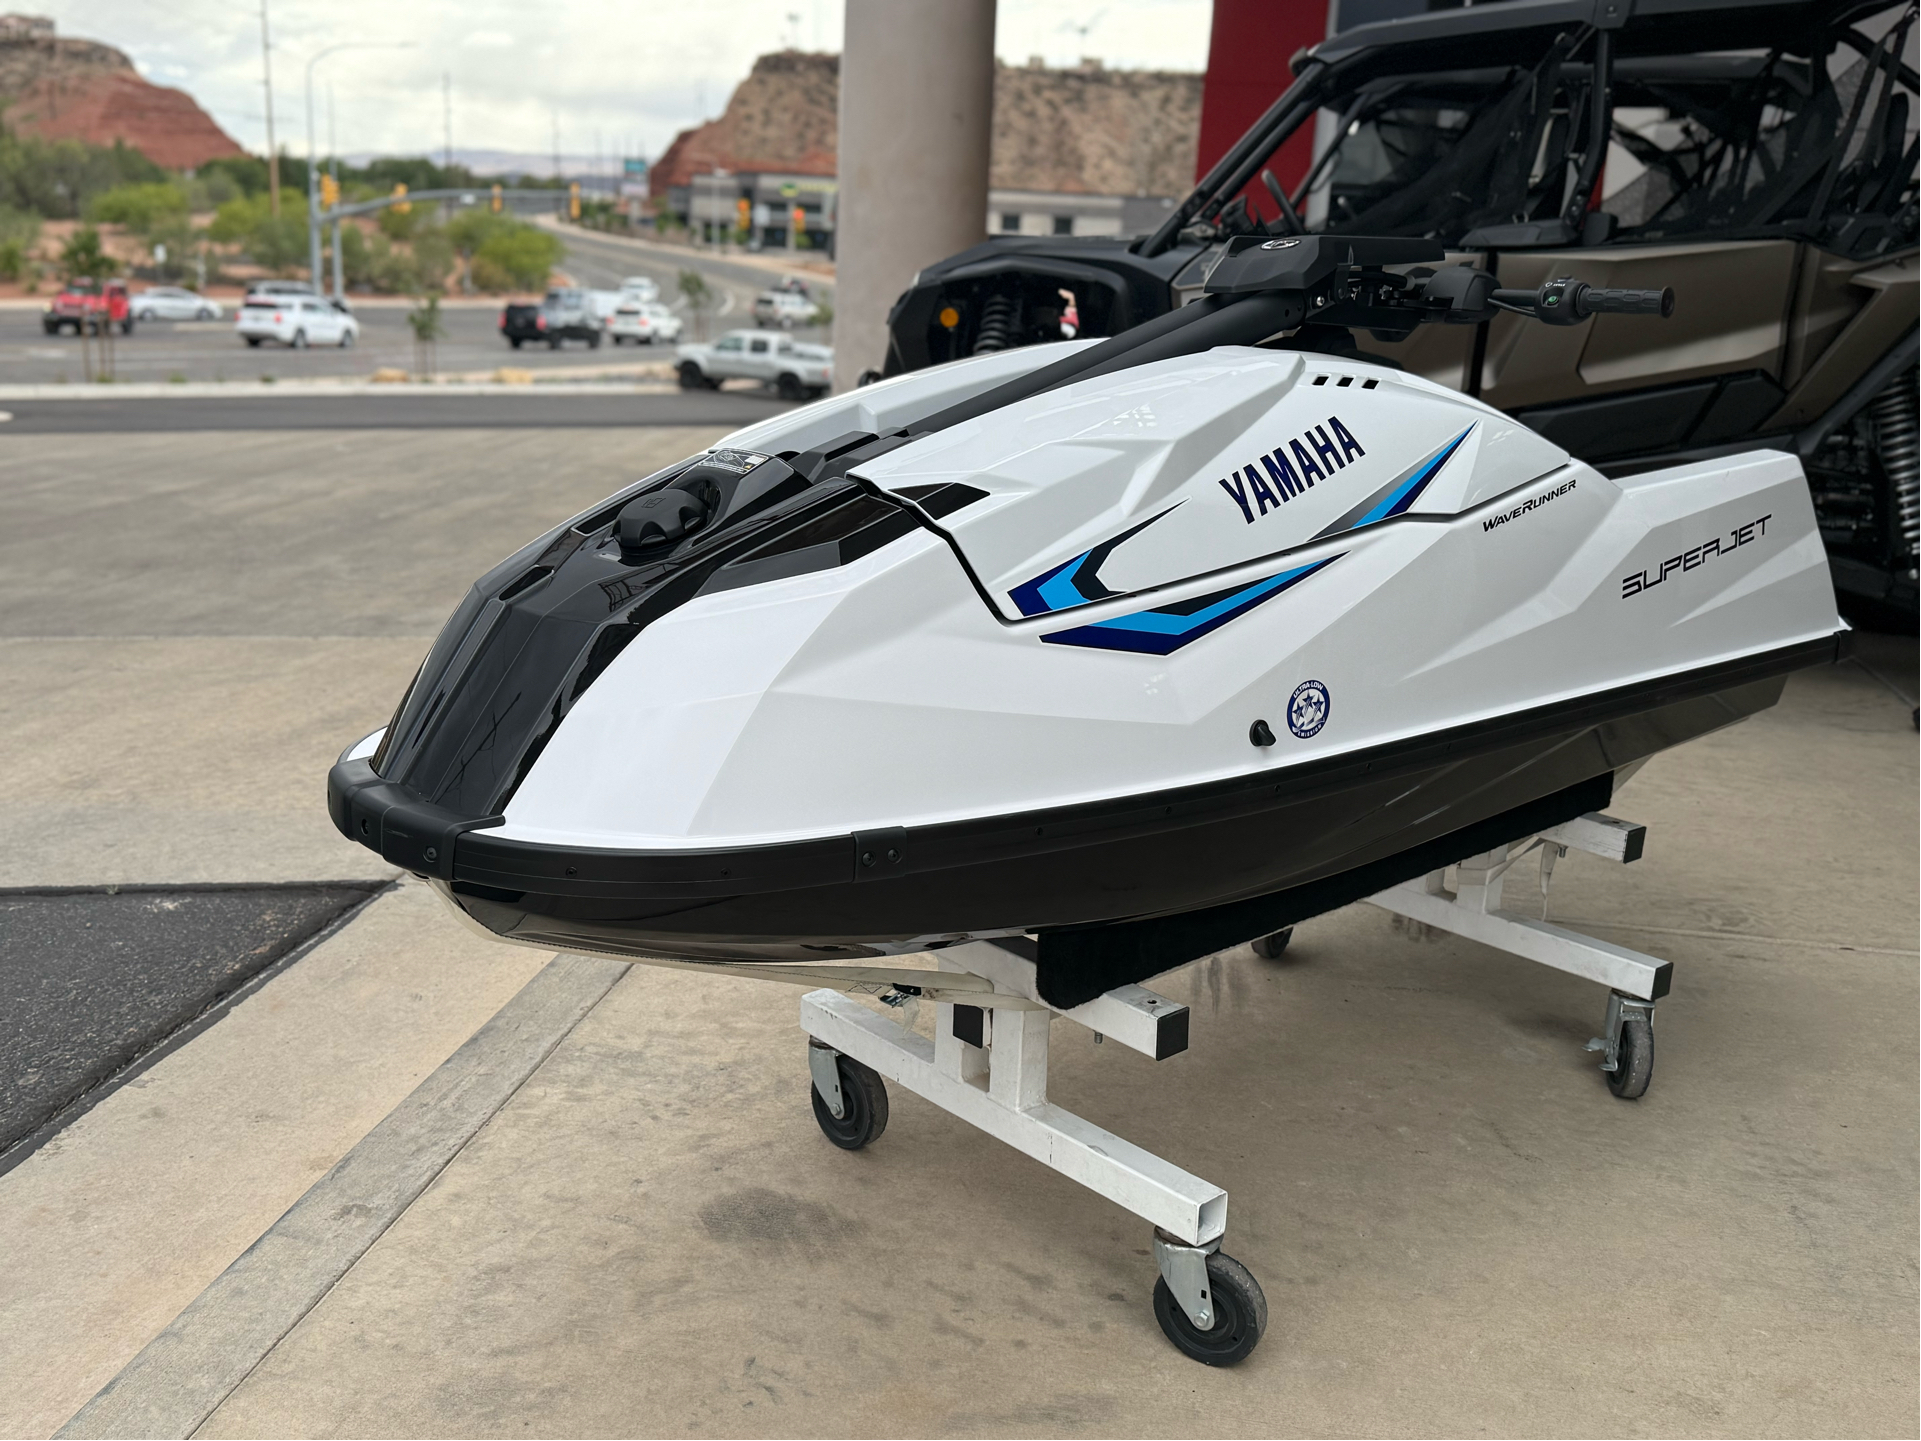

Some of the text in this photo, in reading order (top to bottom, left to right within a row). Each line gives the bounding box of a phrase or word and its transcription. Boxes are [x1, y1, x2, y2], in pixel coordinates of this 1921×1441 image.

[1218, 415, 1366, 525] YAMAHA
[1621, 513, 1772, 600] SUPERJET
[1310, 681, 1324, 691] LOW
